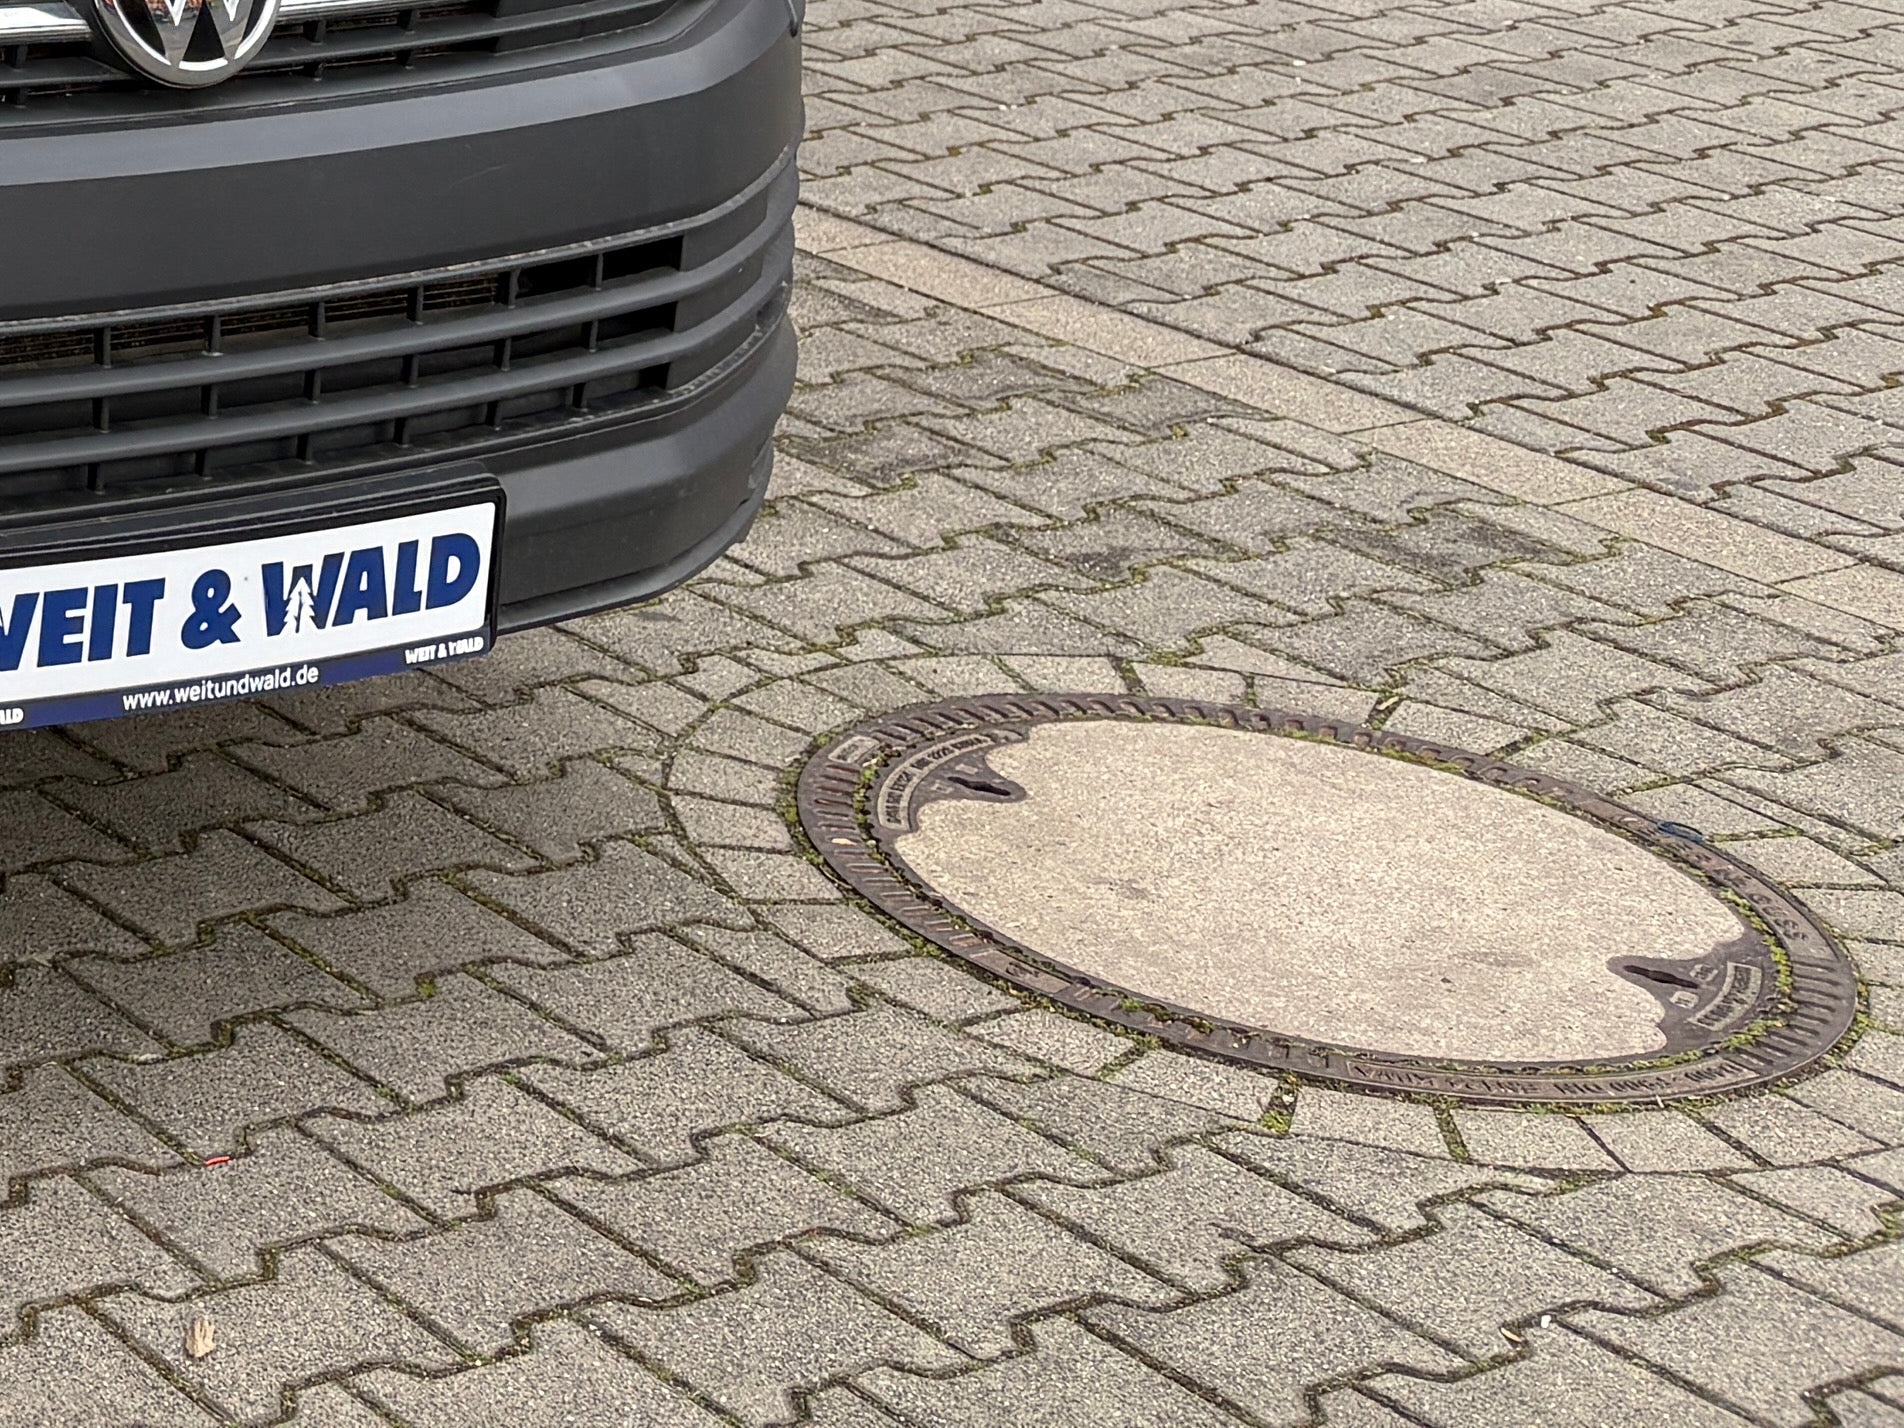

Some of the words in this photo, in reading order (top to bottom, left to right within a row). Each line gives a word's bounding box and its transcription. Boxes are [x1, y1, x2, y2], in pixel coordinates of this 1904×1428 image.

[180, 568, 241, 650] &
[261, 532, 481, 637] WALD
[122, 665, 319, 711] www.weitundwald.de
